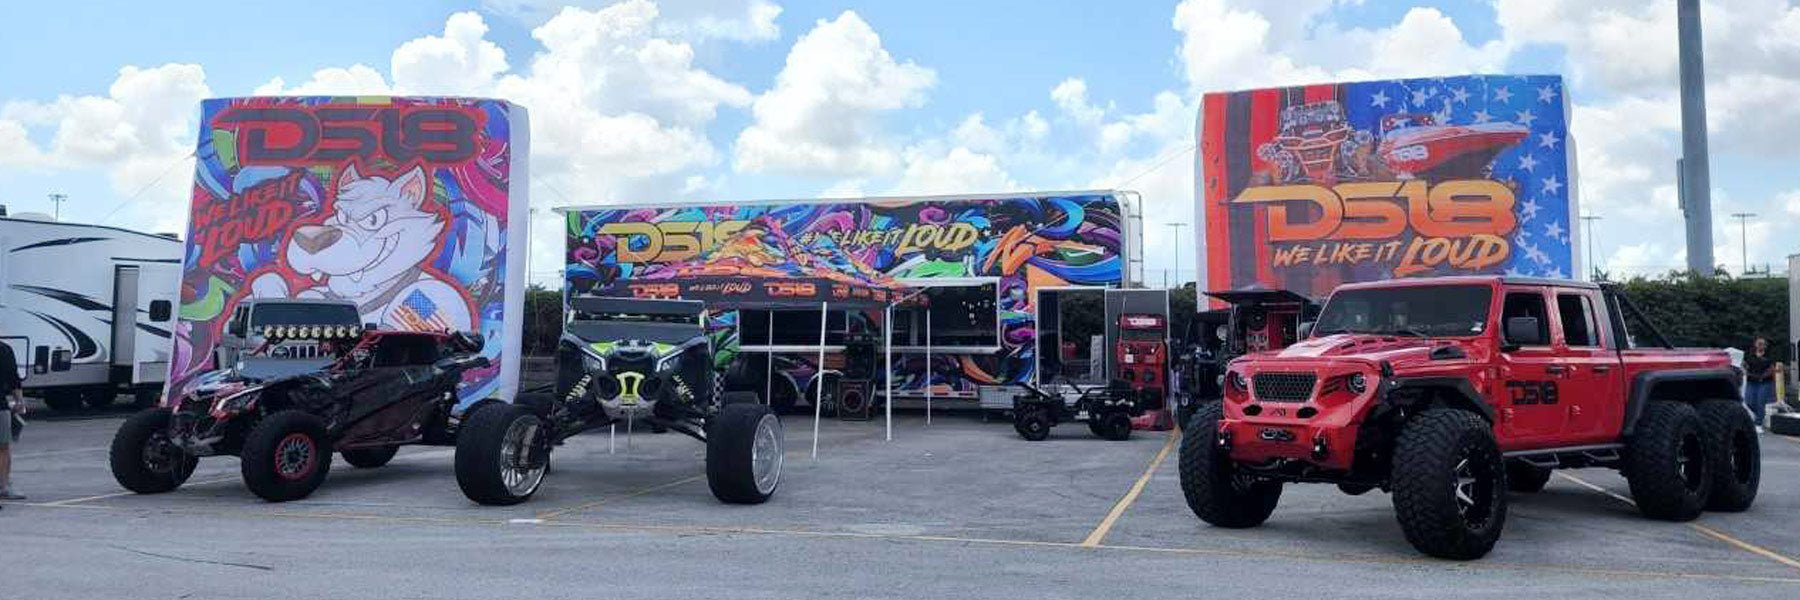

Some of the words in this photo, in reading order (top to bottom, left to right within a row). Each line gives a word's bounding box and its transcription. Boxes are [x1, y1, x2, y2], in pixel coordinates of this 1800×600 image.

[212, 107, 477, 161] DS18
[199, 200, 293, 268] LOUD
[1233, 179, 1517, 241] DS18
[895, 222, 978, 259] LOUD
[1274, 245, 1312, 268] WE
[1313, 242, 1373, 266] LIKE
[1375, 240, 1402, 264] IT
[1393, 233, 1509, 277] LOUD
[763, 282, 817, 297] DS18
